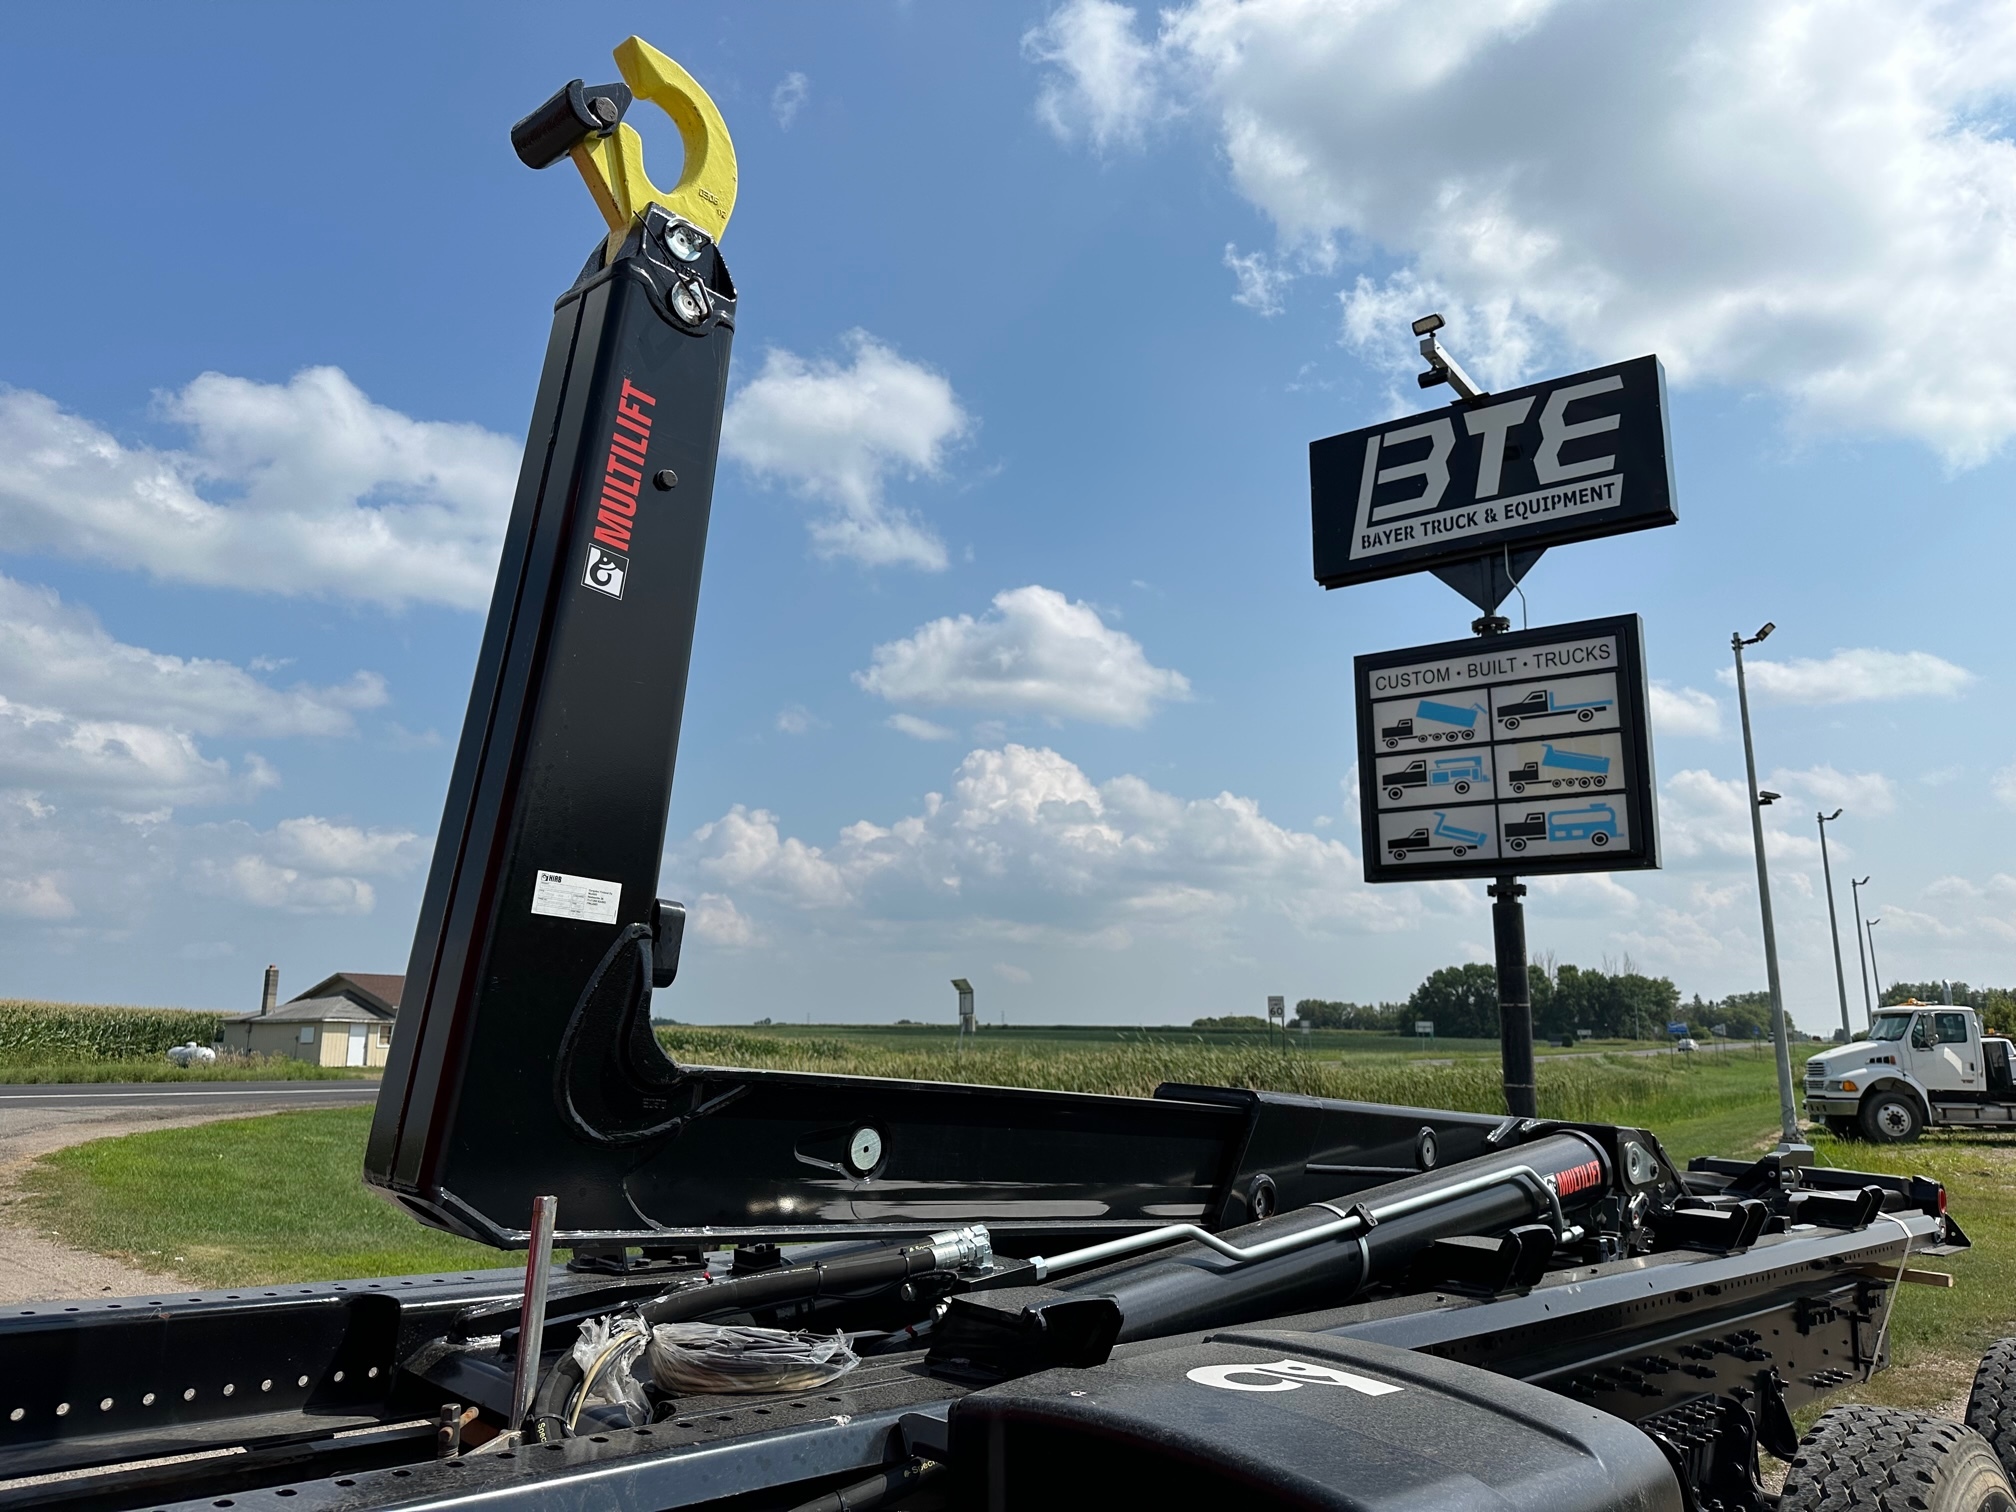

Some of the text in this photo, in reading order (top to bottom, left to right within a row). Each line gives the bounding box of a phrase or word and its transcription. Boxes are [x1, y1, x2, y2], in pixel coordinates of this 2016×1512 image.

[593, 378, 657, 551] MULTILIFT
[1361, 374, 1624, 528] BTE
[1361, 482, 1615, 549] BAYER TRUCK & EQUIPMENT
[1375, 643, 1611, 691] CUSTOM BUILT TRUCKS
[1270, 1007, 1283, 1016] 60
[1555, 1160, 1601, 1197] MULTILIFT
[537, 1422, 548, 1443] Spec
